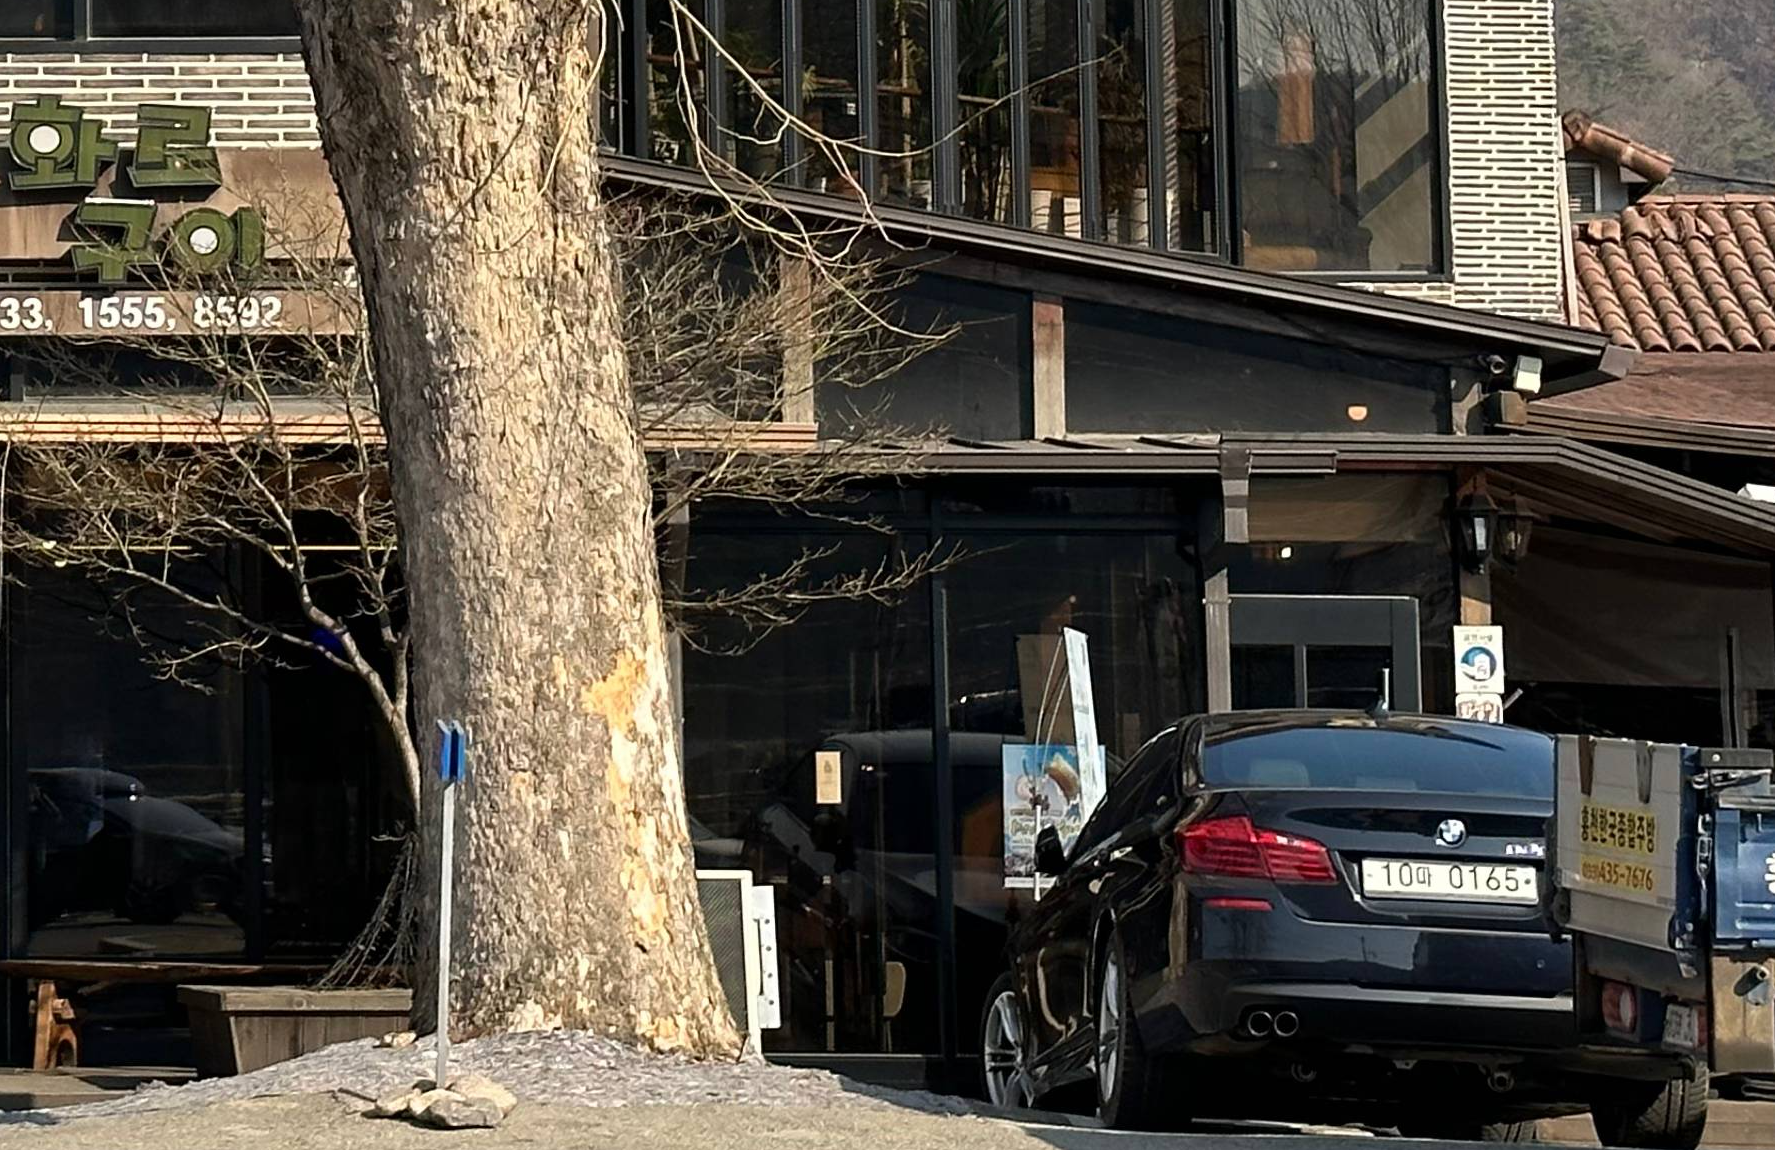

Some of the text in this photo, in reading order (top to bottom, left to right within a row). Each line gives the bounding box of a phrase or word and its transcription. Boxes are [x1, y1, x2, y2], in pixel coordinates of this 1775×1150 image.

[8, 95, 221, 188] 화로
[71, 197, 266, 286] 구이
[78, 296, 176, 331] 1555,
[194, 295, 284, 328] 8592
[1448, 864, 1520, 892] 0165
